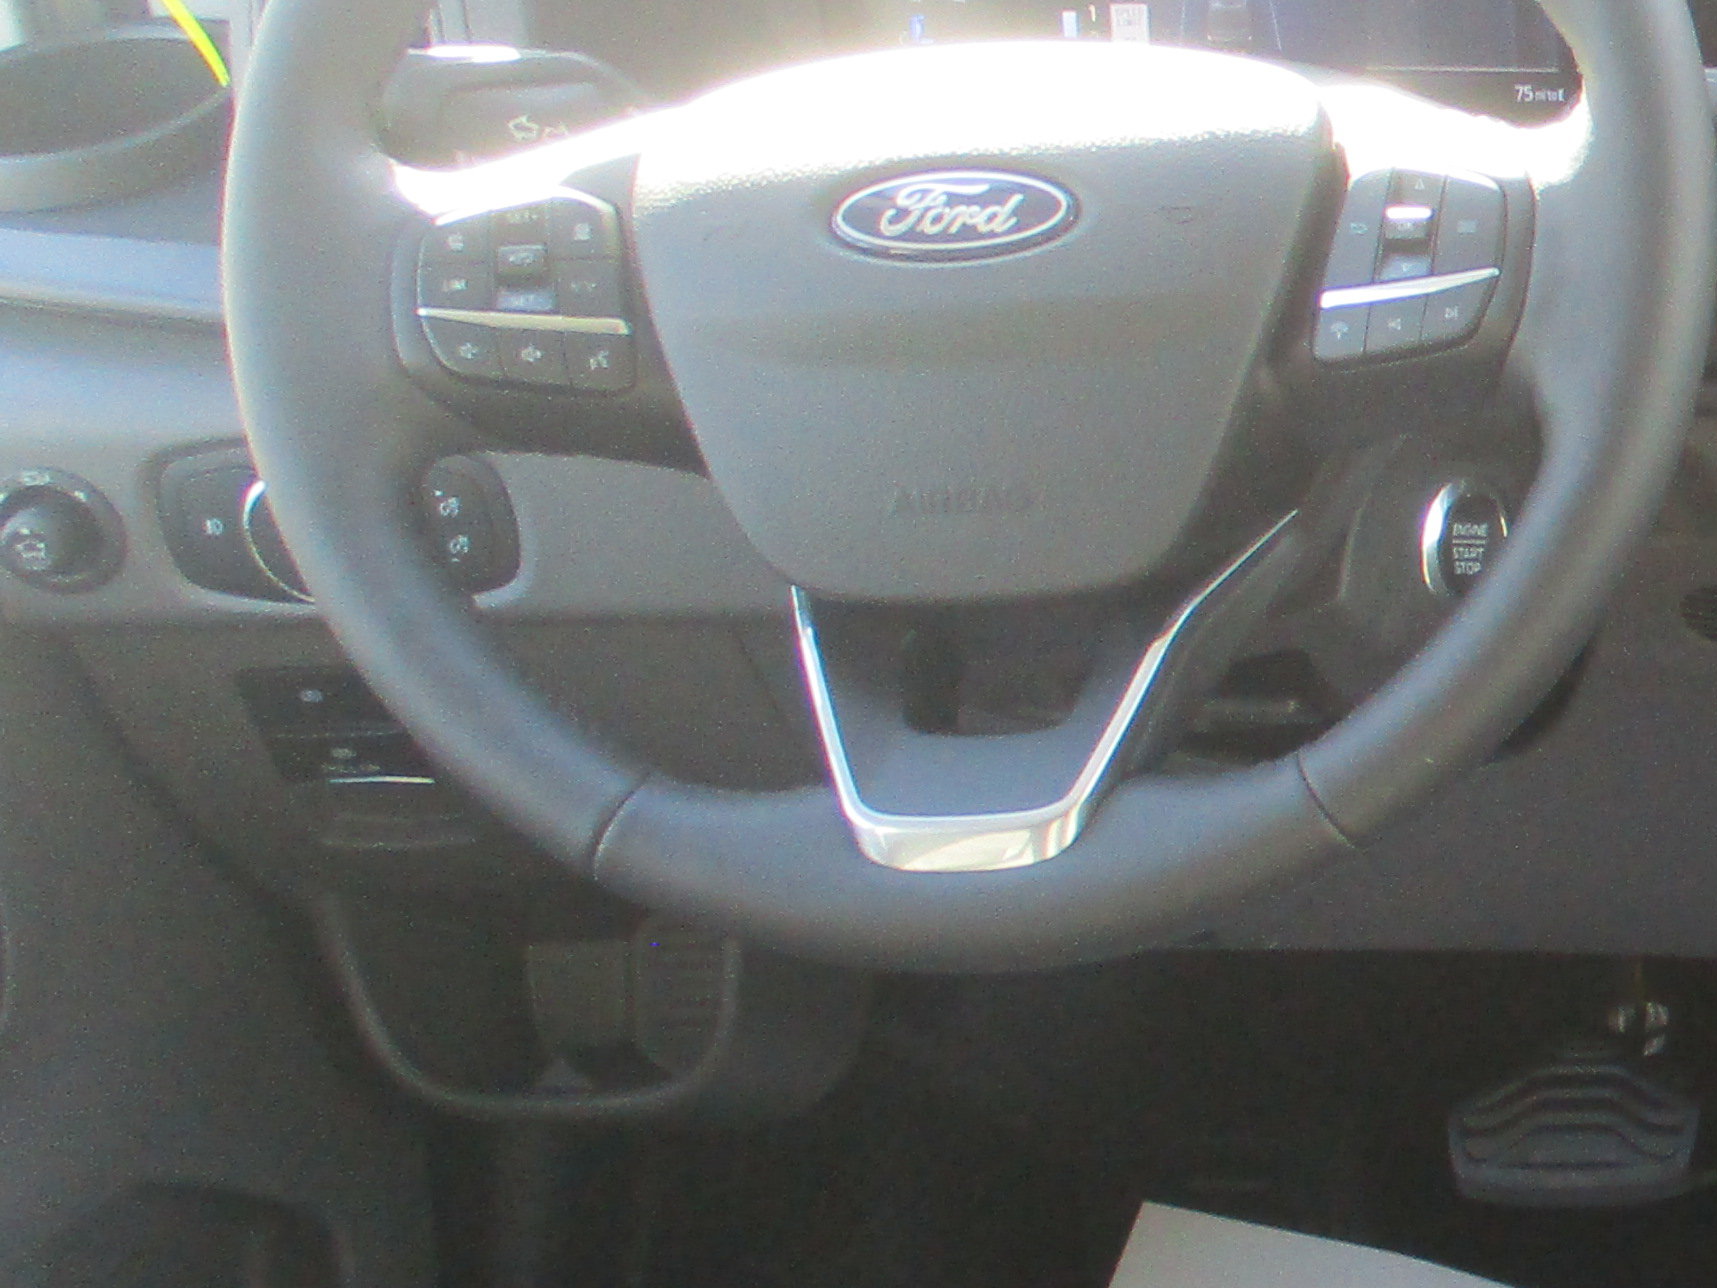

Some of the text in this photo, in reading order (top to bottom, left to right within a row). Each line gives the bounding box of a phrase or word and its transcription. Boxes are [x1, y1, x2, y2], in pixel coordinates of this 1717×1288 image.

[1514, 84, 1534, 102] 75
[878, 182, 1024, 238] Ford
[1453, 547, 1486, 560] START
[1454, 561, 1482, 575] STOP
